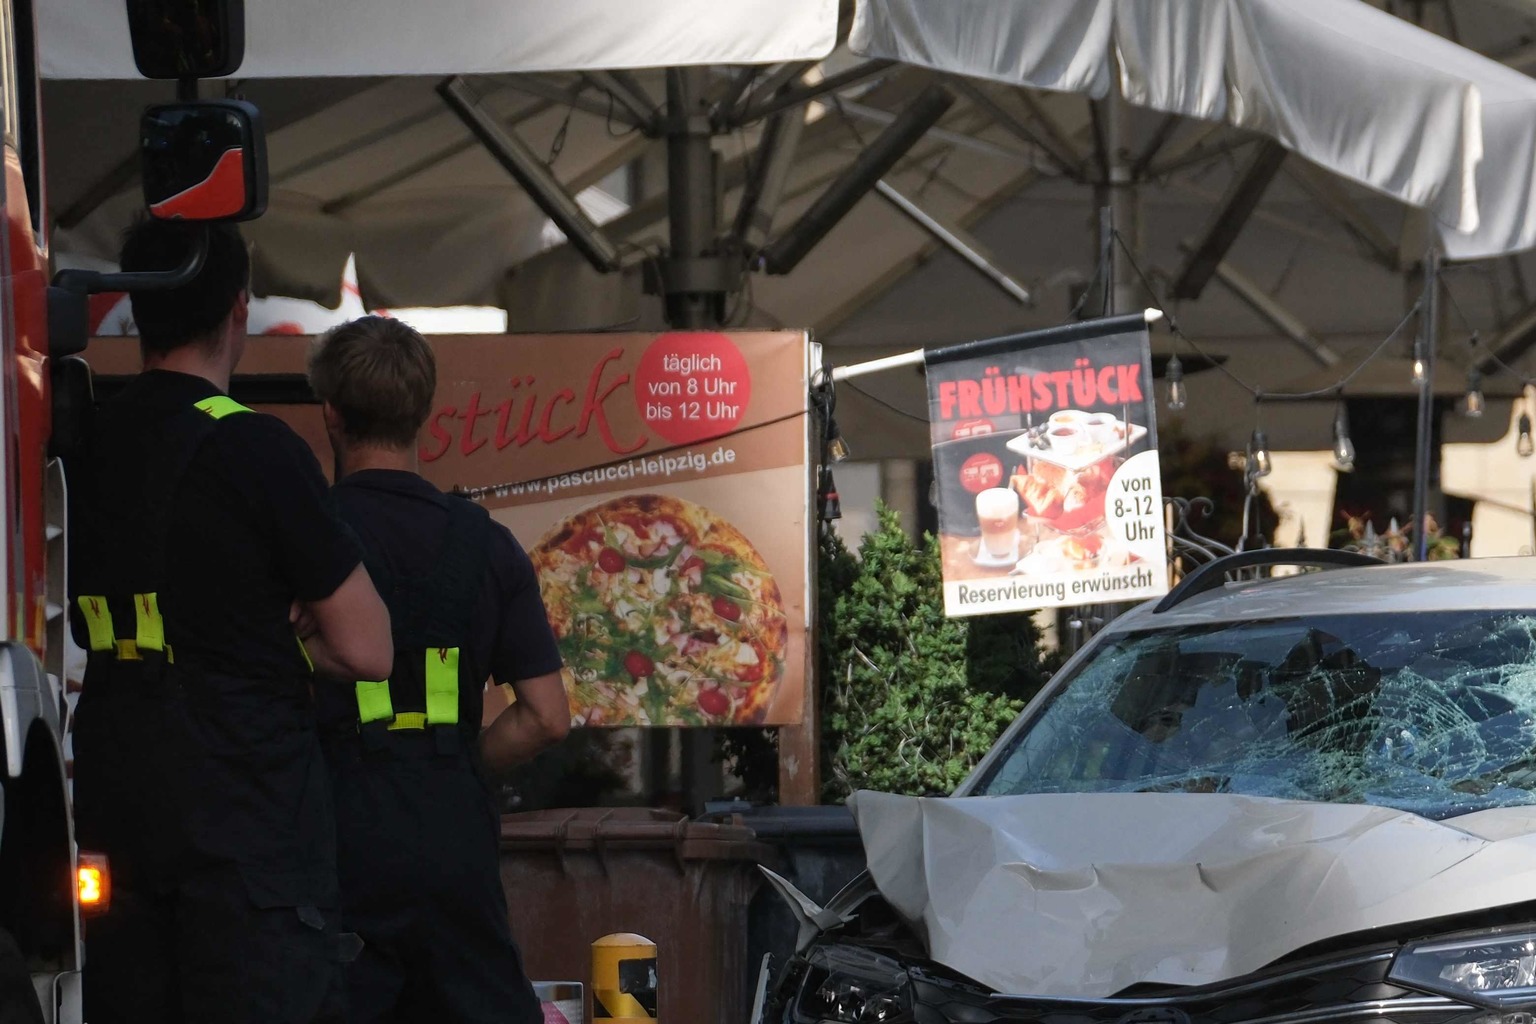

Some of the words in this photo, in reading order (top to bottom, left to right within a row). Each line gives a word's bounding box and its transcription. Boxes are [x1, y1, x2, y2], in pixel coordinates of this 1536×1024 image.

[663, 353, 721, 376] täglich
[648, 382, 680, 395] von
[686, 377, 698, 395] 8
[704, 377, 737, 395] Uhr
[940, 358, 1142, 418] FRÜHSTÜCK
[419, 348, 648, 462] stück
[646, 402, 672, 419] bis
[679, 402, 700, 419] 12
[706, 402, 739, 419] Uhr
[1121, 475, 1152, 494] von
[1114, 495, 1154, 519] 8-12
[1125, 520, 1156, 542] Uhr
[958, 581, 1065, 604] Reservierung
[1071, 566, 1153, 594] erwünscht
